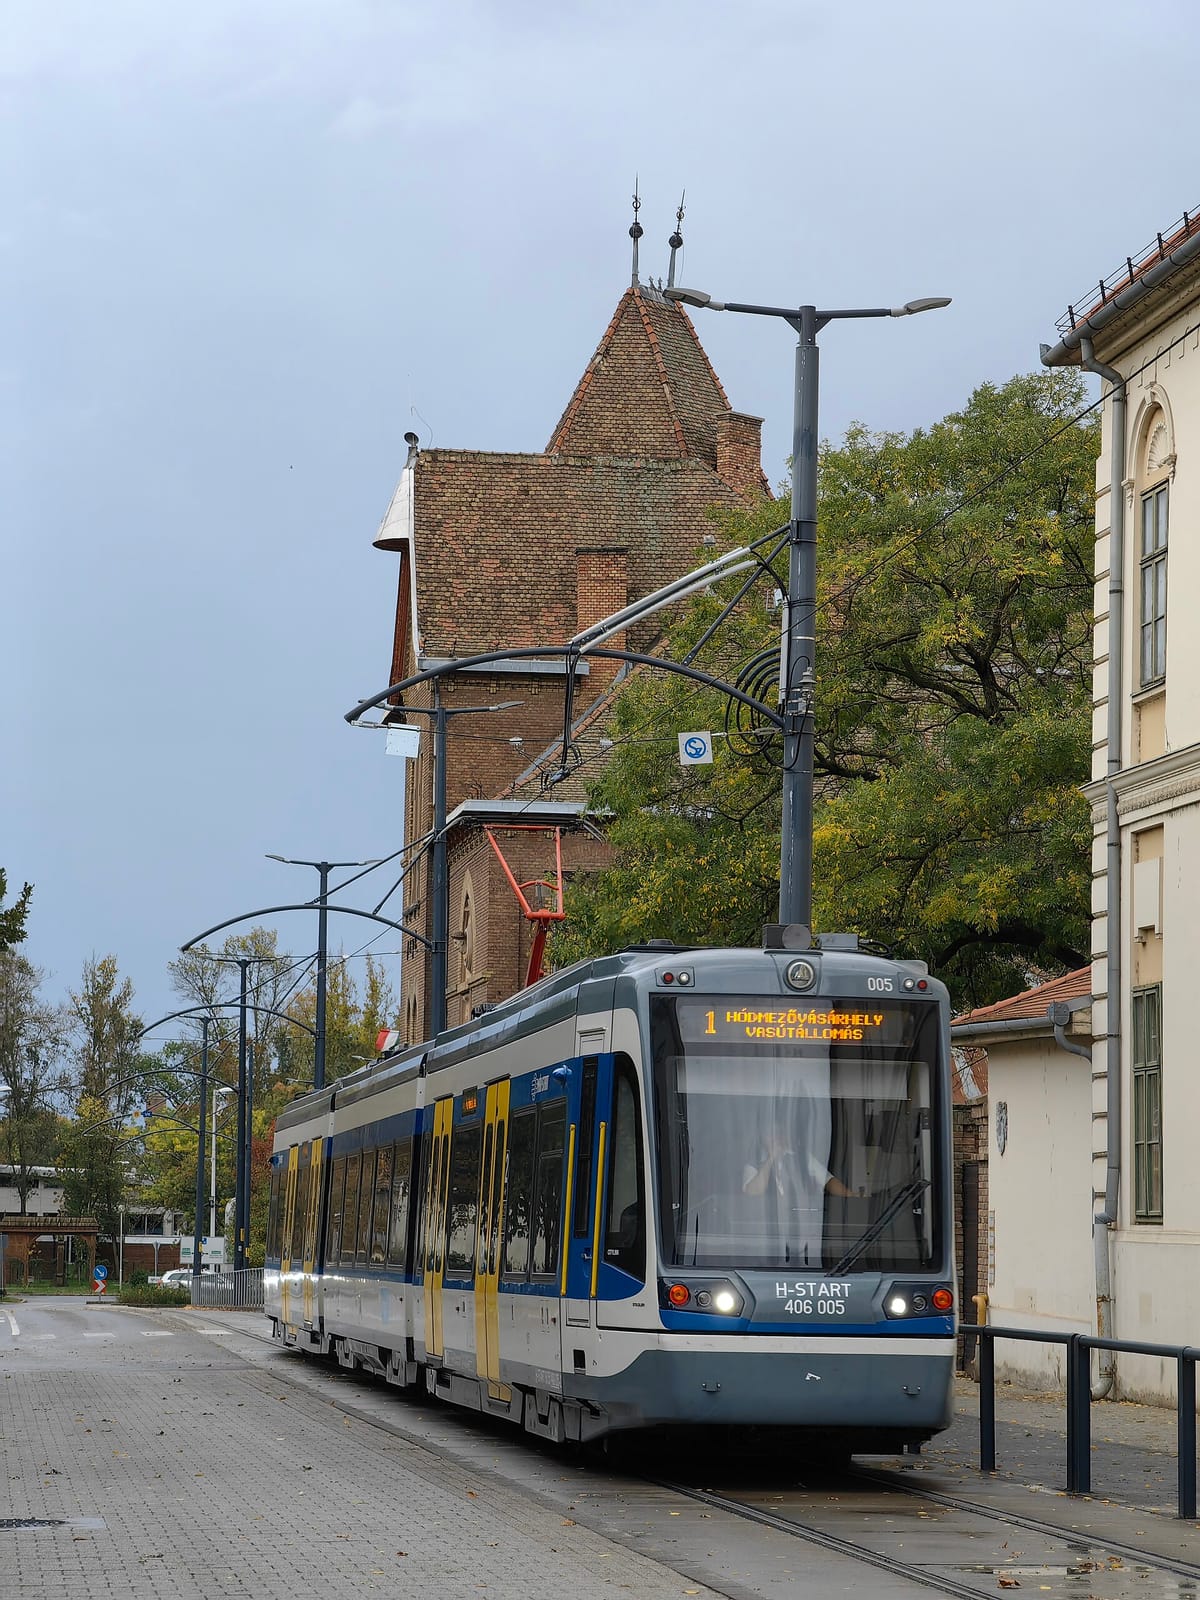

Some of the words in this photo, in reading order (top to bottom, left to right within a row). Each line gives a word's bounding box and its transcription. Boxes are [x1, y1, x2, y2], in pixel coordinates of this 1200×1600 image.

[868, 977, 893, 992] 005
[704, 1011, 716, 1034] 1
[726, 1008, 883, 1025] HÓDMEZŐVÁSÁRHELY
[745, 1024, 863, 1040] VASÚTÁLLOMÁS
[775, 1282, 851, 1298] H-START
[784, 1299, 812, 1314] 406
[817, 1300, 845, 1315] 005
